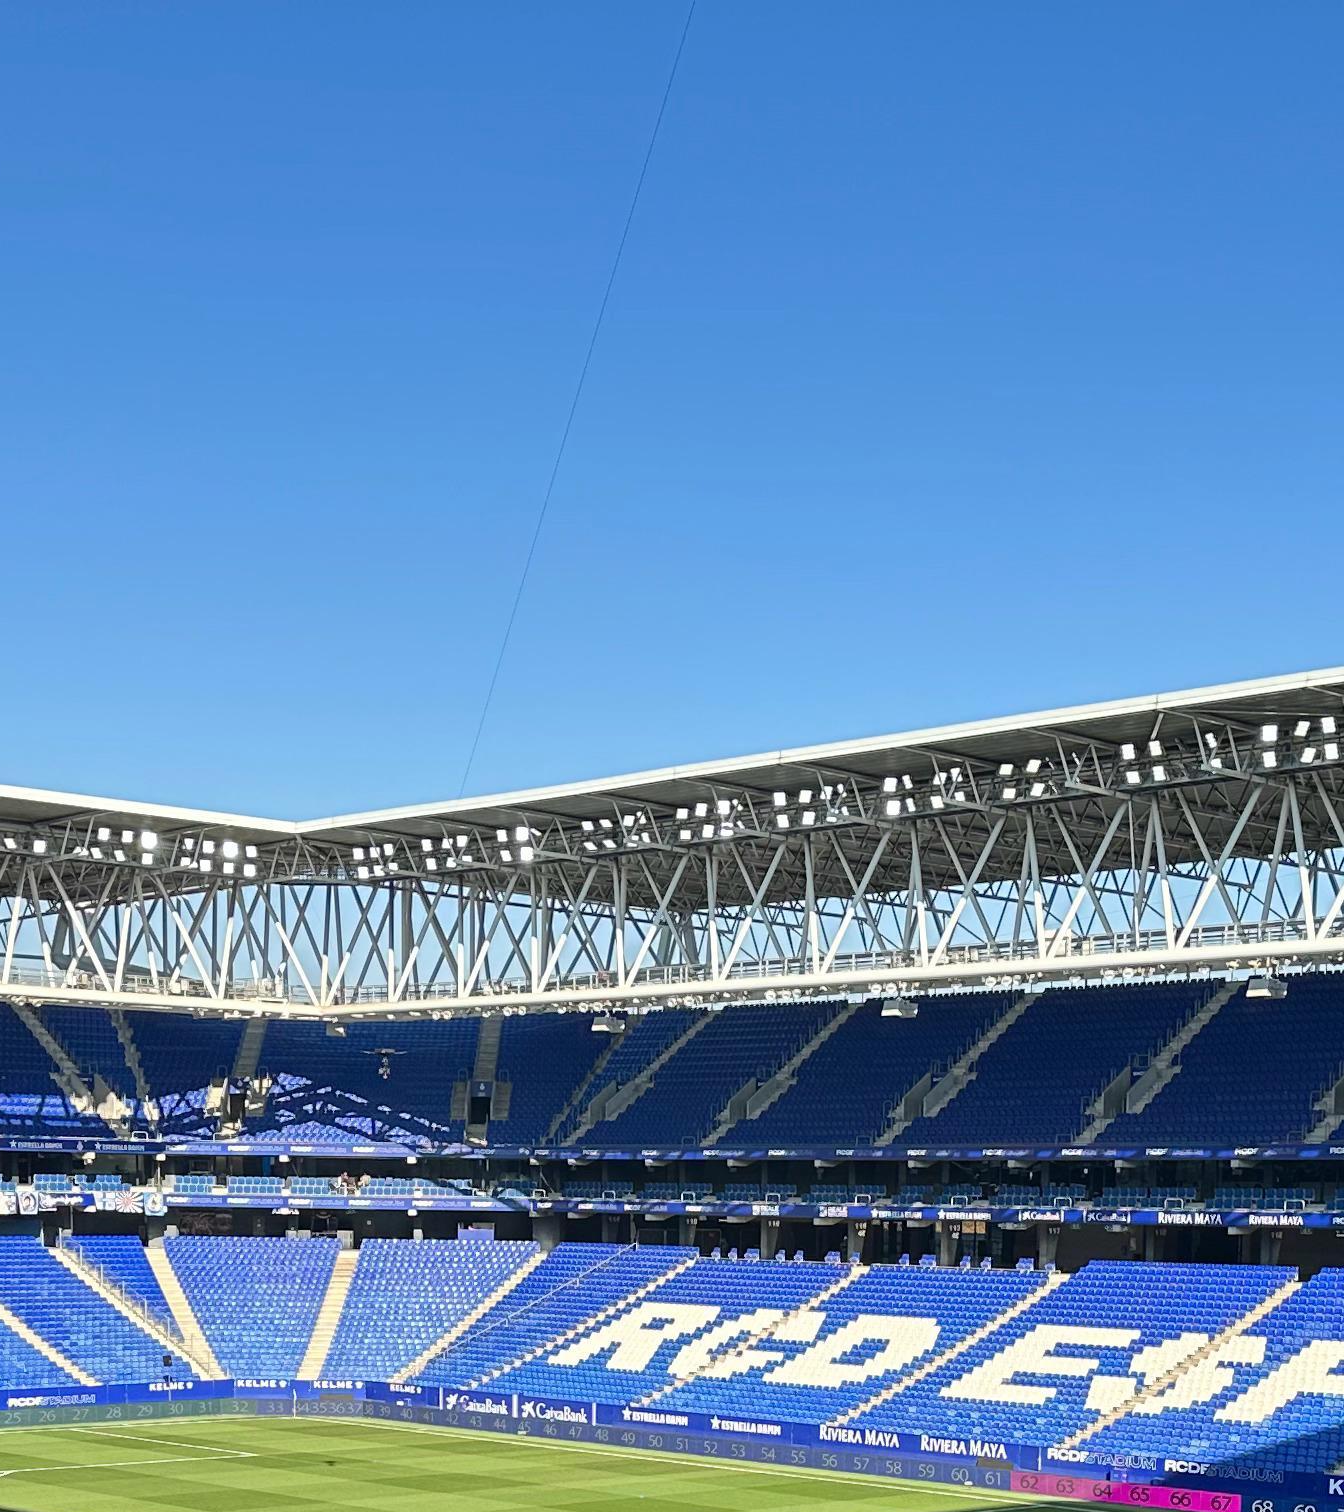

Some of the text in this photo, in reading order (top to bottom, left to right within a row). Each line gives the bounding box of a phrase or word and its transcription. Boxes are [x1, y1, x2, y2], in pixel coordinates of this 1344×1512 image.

[1158, 1212, 1222, 1225] RIVIERA MAYA
[1249, 1214, 1304, 1226] RIVIERA MAYA
[547, 1302, 944, 1390] RCD
[237, 1379, 276, 1389] KELME
[313, 1380, 353, 1390] KELME
[4, 1411, 21, 1424] 25
[39, 1409, 56, 1421] 26
[72, 1407, 89, 1420] 27
[105, 1405, 122, 1418] 28
[136, 1402, 153, 1415] 29
[168, 1401, 184, 1414] 30
[199, 1400, 214, 1413] 31
[232, 1400, 249, 1413] 32
[460, 1396, 508, 1416] CaixaBank
[536, 1402, 588, 1424] CaixaBank
[819, 1423, 900, 1449] RIVIERA MAYA
[920, 1434, 1007, 1460] RIVIERA MAYA
[446, 1411, 459, 1424] 42
[470, 1414, 482, 1427] 43
[494, 1417, 507, 1430] 44
[517, 1420, 531, 1433] 45
[543, 1423, 557, 1436] 46
[569, 1426, 583, 1439] 47
[595, 1428, 609, 1441] 48
[621, 1431, 636, 1445] 49
[648, 1434, 663, 1448] 50
[676, 1438, 689, 1451] 51
[703, 1441, 717, 1455] 52
[731, 1445, 746, 1458] 53
[761, 1448, 776, 1461] 54
[791, 1451, 806, 1465] 55
[821, 1454, 837, 1468] 56
[853, 1458, 869, 1471] 57
[886, 1461, 903, 1475] 58
[918, 1465, 935, 1479] 59
[951, 1468, 969, 1483] 60
[985, 1472, 1001, 1486] 61
[1020, 1475, 1038, 1490] 62
[1056, 1480, 1074, 1495] 63
[1092, 1483, 1112, 1499] 64
[1129, 1487, 1150, 1502] 65
[1170, 1491, 1191, 1507] 66
[1211, 1496, 1232, 1512] 67
